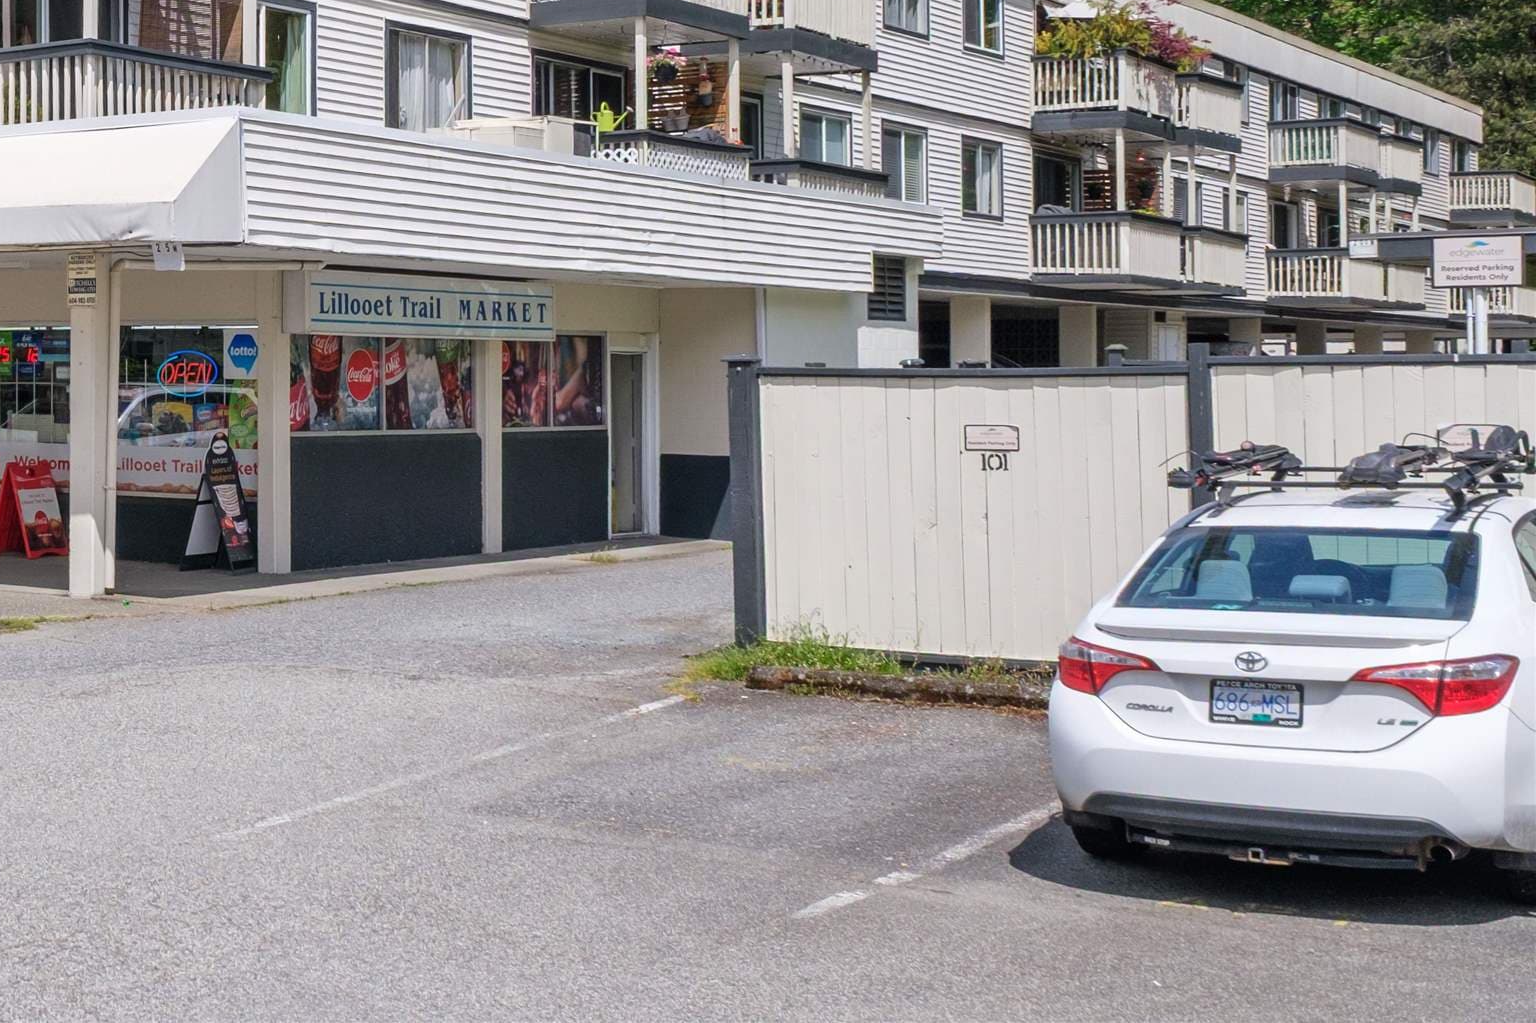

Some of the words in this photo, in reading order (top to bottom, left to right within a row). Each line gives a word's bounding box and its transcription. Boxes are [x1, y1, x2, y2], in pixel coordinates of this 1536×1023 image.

[1448, 248, 1505, 258] edgewater
[1440, 264, 1480, 272] Reserved
[1482, 263, 1514, 272] Parking
[1489, 273, 1509, 281] Only
[319, 291, 393, 316] Lillooet
[400, 295, 441, 319] Trail
[459, 299, 547, 323] MARKET
[160, 361, 212, 385] OPEN
[171, 459, 203, 474] Trail
[981, 453, 1009, 472] 101
[1215, 692, 1249, 712] 686
[1262, 695, 1297, 715] MSL
